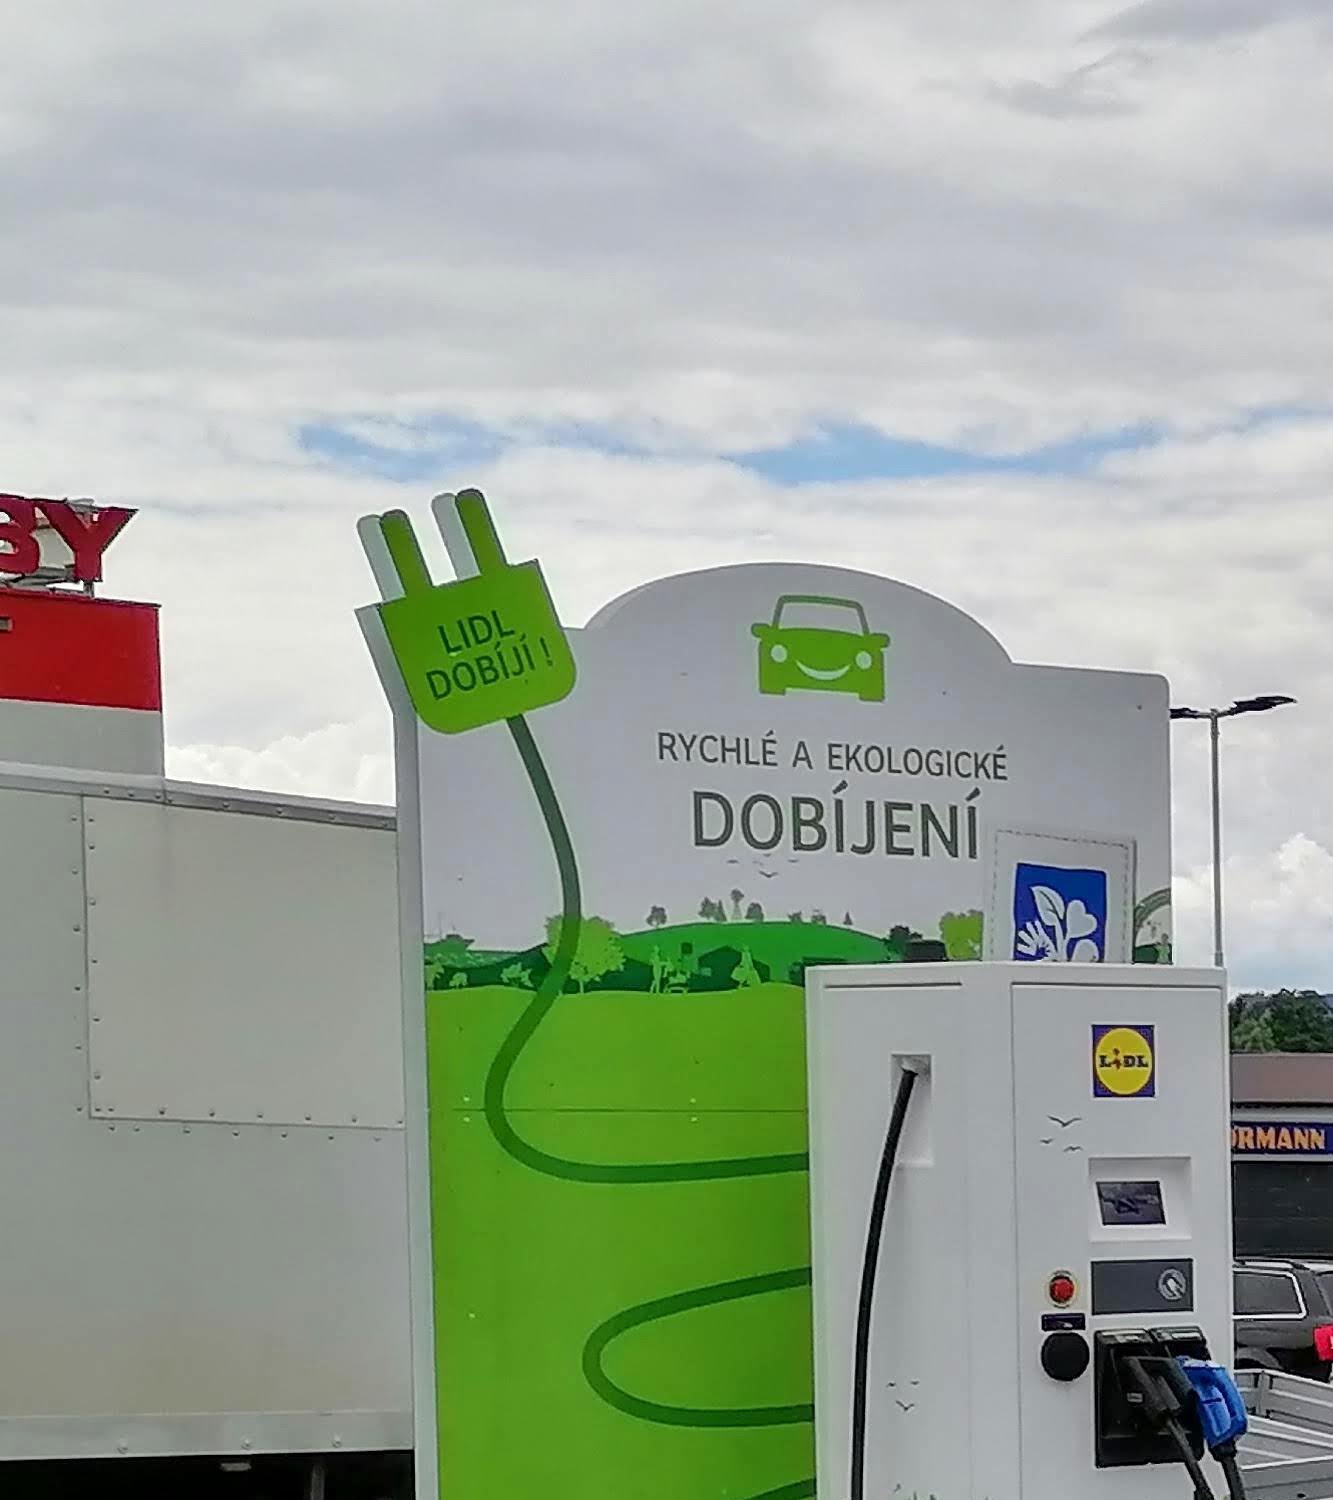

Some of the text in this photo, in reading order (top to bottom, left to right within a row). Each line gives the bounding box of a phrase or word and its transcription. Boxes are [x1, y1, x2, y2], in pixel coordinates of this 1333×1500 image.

[438, 610, 515, 654] LIDL
[658, 730, 1008, 781] RYCHLÉ A EKOLOGICKÉ
[693, 780, 981, 860] DOBÍJENÍ
[1232, 1125, 1326, 1150] RMANN
